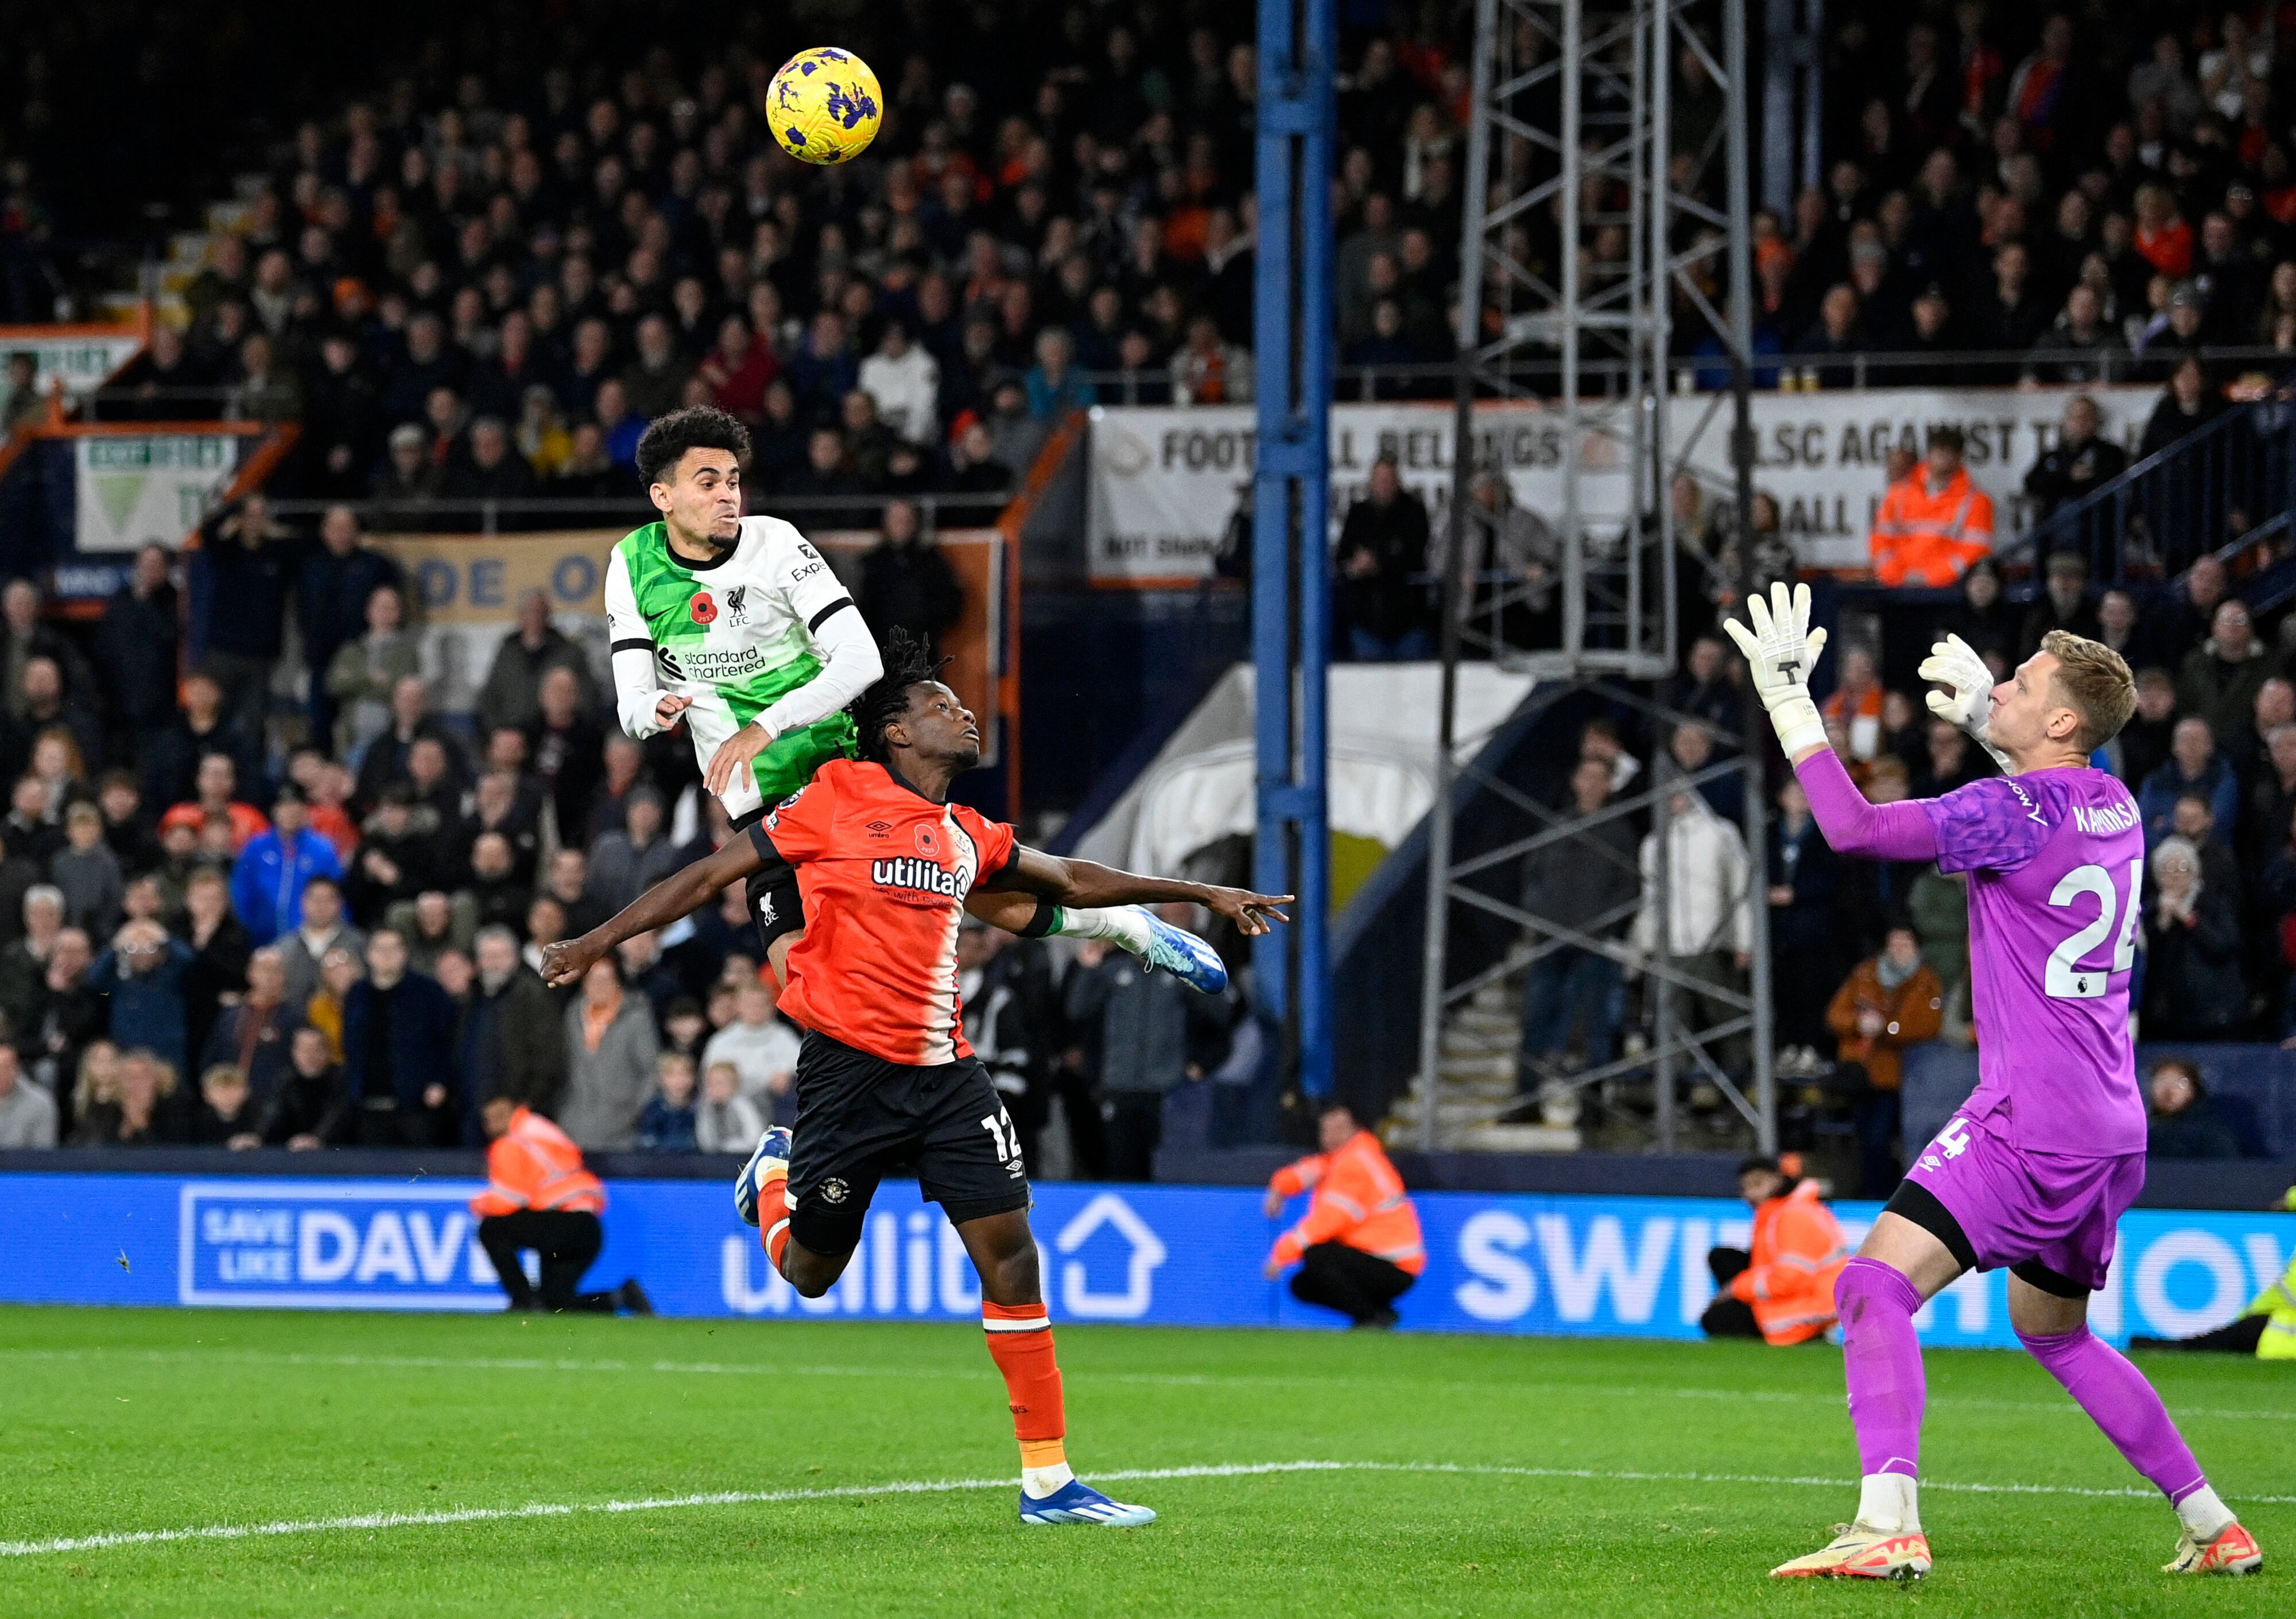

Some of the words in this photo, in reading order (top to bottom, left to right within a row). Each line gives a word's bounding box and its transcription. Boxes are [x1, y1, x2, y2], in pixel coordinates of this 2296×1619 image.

[698, 614, 713, 622] 2023
[685, 645, 758, 665] standard
[874, 857, 955, 898] utilita
[894, 890, 919, 903] with
[981, 1105, 1022, 1162] 12
[1926, 1117, 1971, 1160] 4
